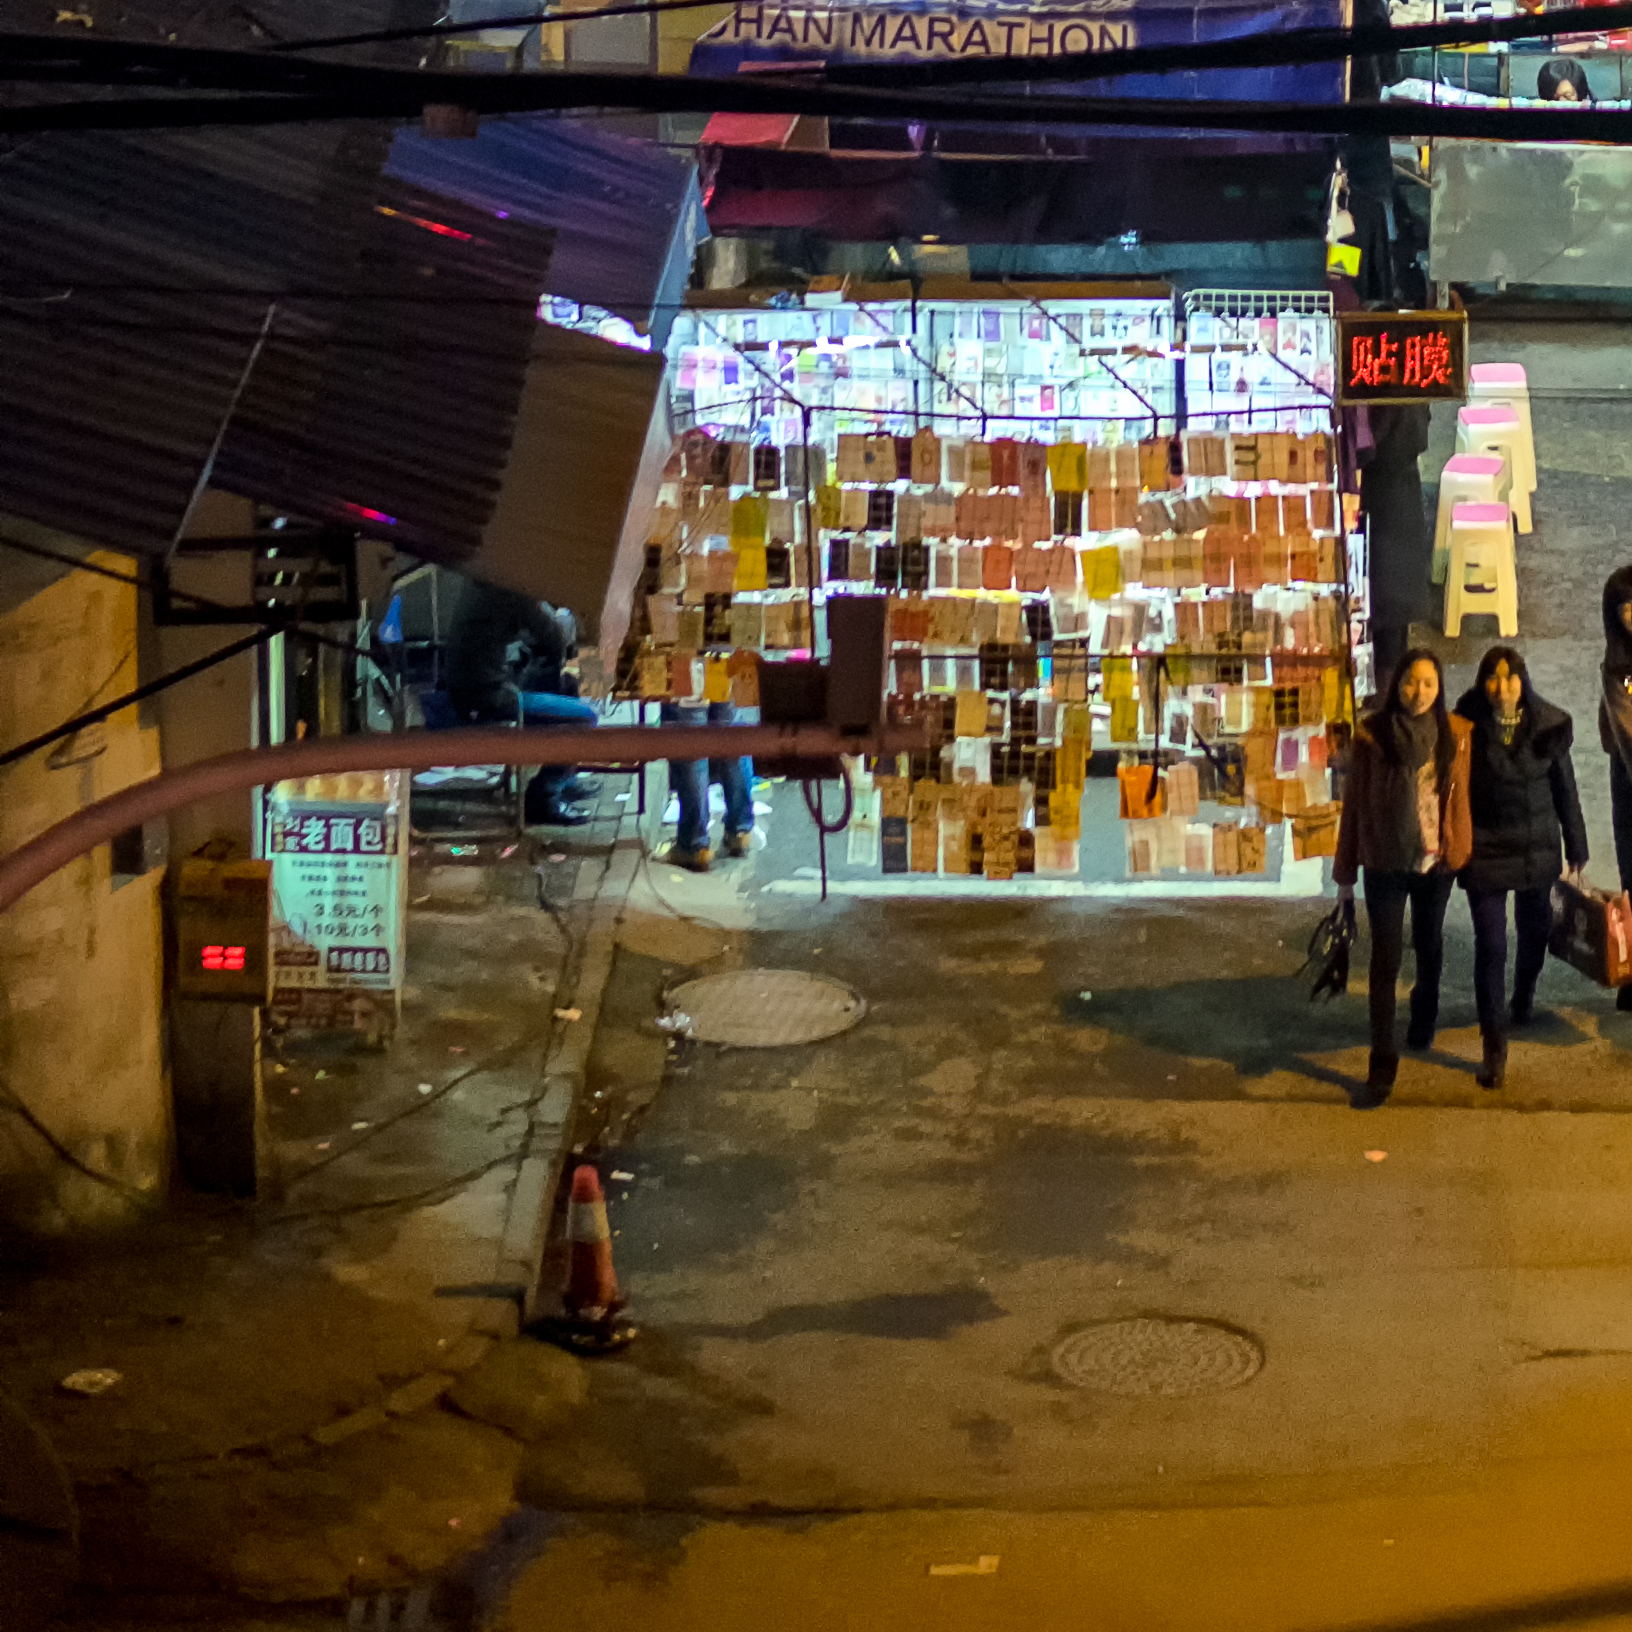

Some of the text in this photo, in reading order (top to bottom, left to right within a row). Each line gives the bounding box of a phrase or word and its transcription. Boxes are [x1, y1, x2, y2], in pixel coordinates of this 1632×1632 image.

[712, 4, 1128, 57] HAN MARATHON
[1349, 331, 1453, 388] 贴膜
[301, 816, 383, 852] 老面包
